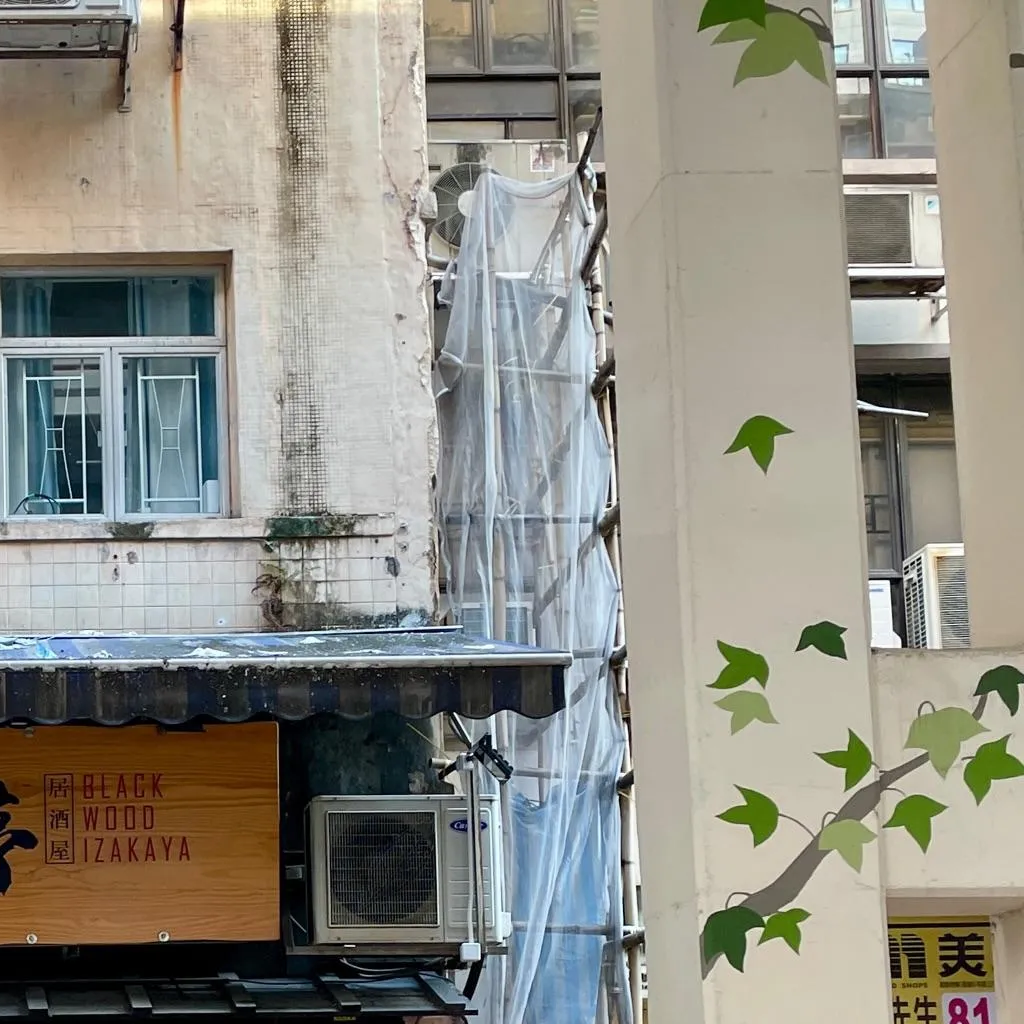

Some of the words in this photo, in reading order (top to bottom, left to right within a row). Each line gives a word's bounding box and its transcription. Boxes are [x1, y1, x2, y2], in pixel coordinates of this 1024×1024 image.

[82, 773, 164, 799] BLACK
[48, 778, 70, 862] 居酒屋
[82, 805, 156, 831] WOOD
[83, 837, 191, 863] IZAKAYA
[938, 933, 987, 978] 美
